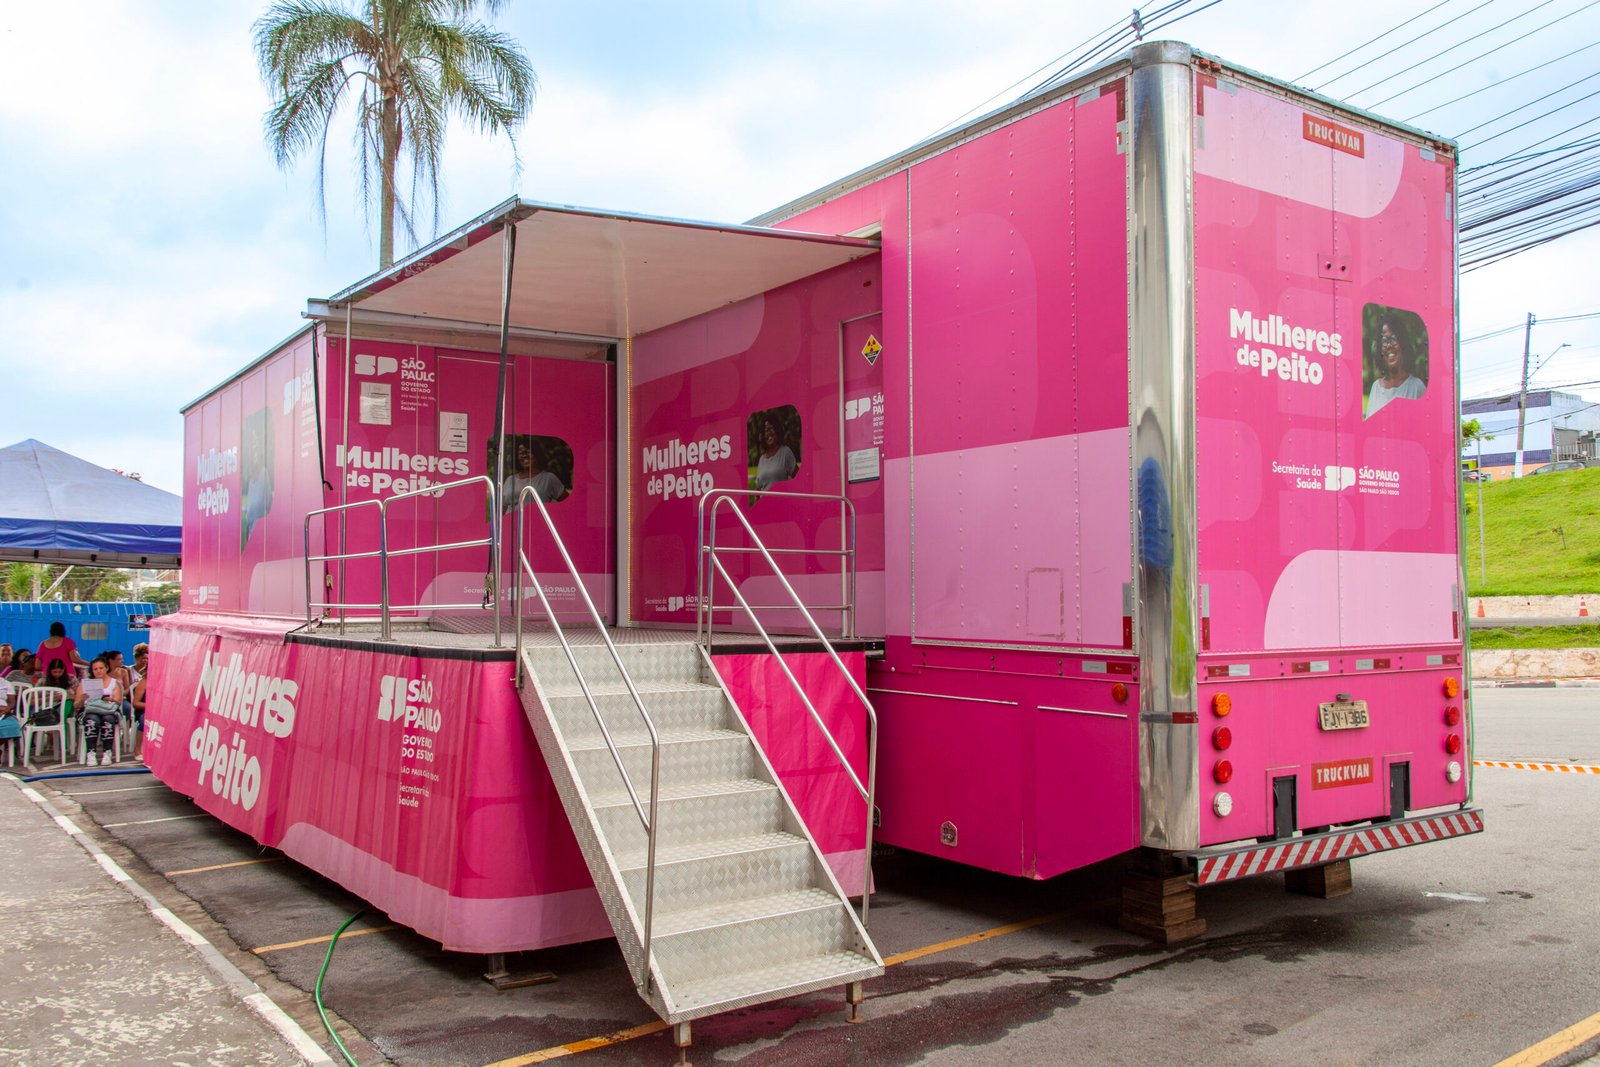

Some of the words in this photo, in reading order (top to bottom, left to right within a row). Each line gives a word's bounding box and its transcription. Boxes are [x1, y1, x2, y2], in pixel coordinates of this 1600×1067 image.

[1308, 120, 1360, 151] TRUCKVAN
[1230, 308, 1342, 356] Mulheres
[401, 358, 425, 370] SÃO
[1261, 348, 1323, 385] Peito
[197, 446, 237, 486] Mulheres
[336, 444, 469, 475] Mulheres
[643, 435, 731, 473] Mulheres
[1272, 461, 1309, 476] Secretaria
[1311, 464, 1321, 476] da
[1296, 477, 1321, 489] Saúde
[1359, 466, 1374, 480] SÃO
[1376, 470, 1399, 481] PAULO
[407, 674, 433, 704] SÃO
[404, 705, 441, 733] PAULO
[1317, 763, 1370, 784] TRUCKVAN
